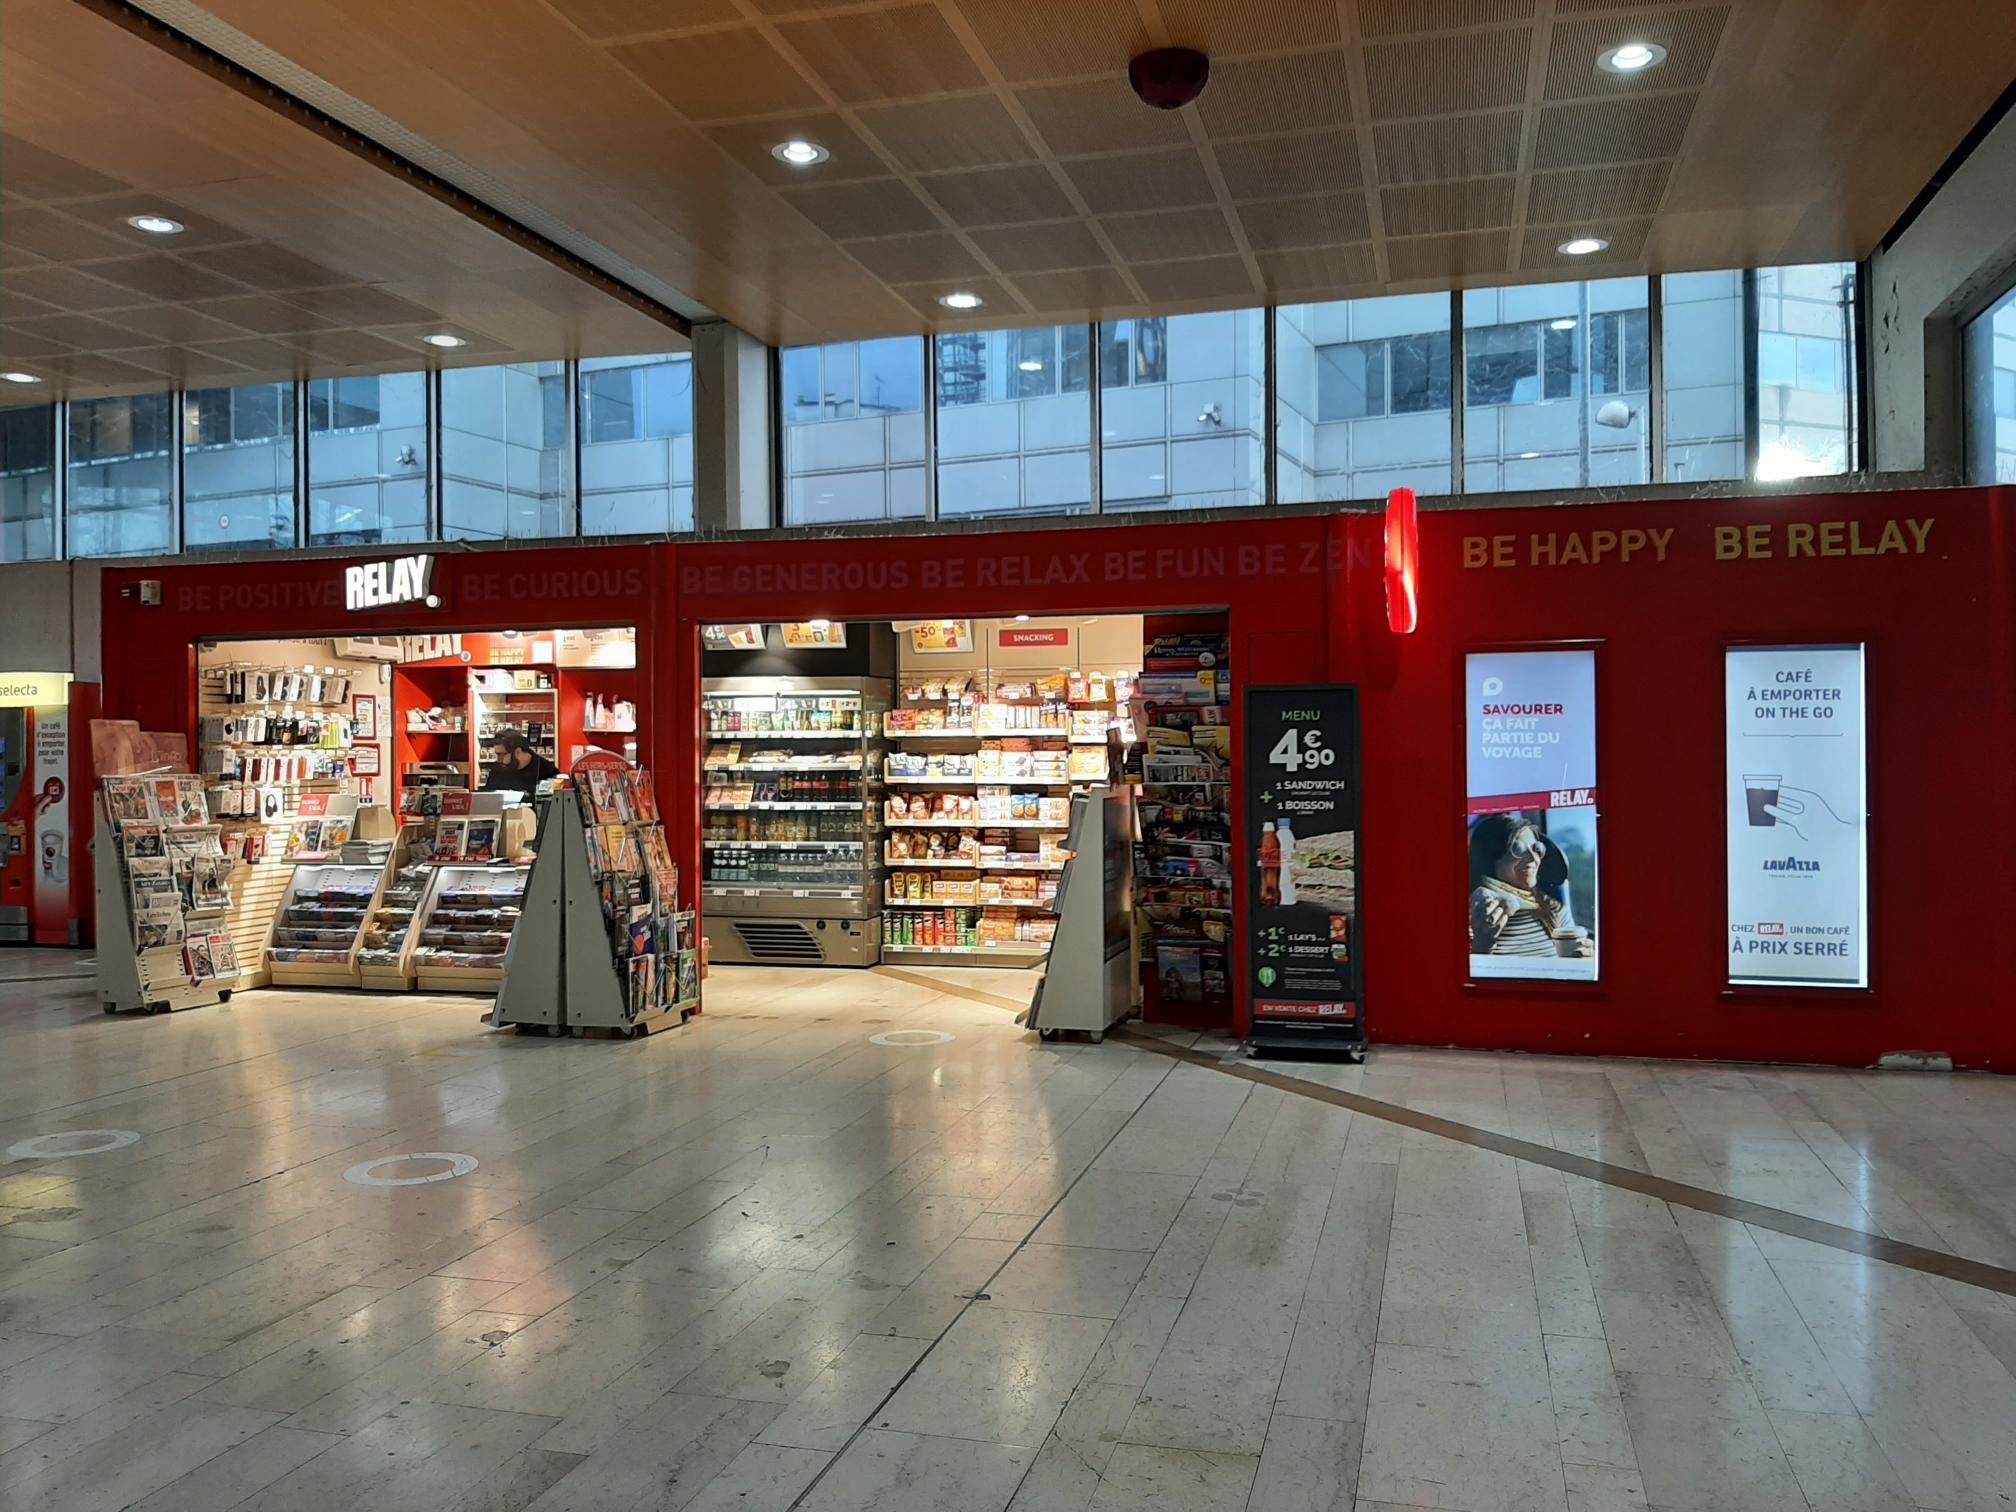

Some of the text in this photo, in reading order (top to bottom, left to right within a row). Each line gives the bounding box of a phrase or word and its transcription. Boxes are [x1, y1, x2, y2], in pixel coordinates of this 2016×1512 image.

[1714, 518, 1935, 560] BE RELAY
[1463, 527, 1676, 568] BE HAPPY
[683, 538, 1372, 593] BE GENEROUS BE RELAX BE FUN BE ZEN
[345, 554, 430, 611] RELAY
[463, 568, 643, 600] BE CURIOUS
[177, 579, 339, 612] BE POSITIVE
[1013, 633, 1054, 642] SNACKING
[1776, 668, 1813, 683] CAFÉ
[1747, 686, 1841, 701] À EMPORTER
[1281, 710, 1321, 721] MENU
[1482, 703, 1564, 715] SAVOURER
[1755, 707, 1834, 719] ON THE GO
[1482, 717, 1539, 731] ÇA FAIT
[1482, 732, 1560, 744] PARTIE DU
[1482, 746, 1542, 759] VOYAGE
[1284, 780, 1345, 790] SANDWICH
[1285, 801, 1334, 810] BOISSON
[1731, 924, 1755, 933] CHEZ
[1790, 926, 1803, 934] UN
[1805, 926, 1825, 935] BON
[1827, 925, 1850, 935] CAFÉ
[1294, 945, 1330, 953] DESSERT
[1732, 936, 1849, 957] À PRIX SERRÉ
[1278, 1005, 1296, 1013] VENTE
